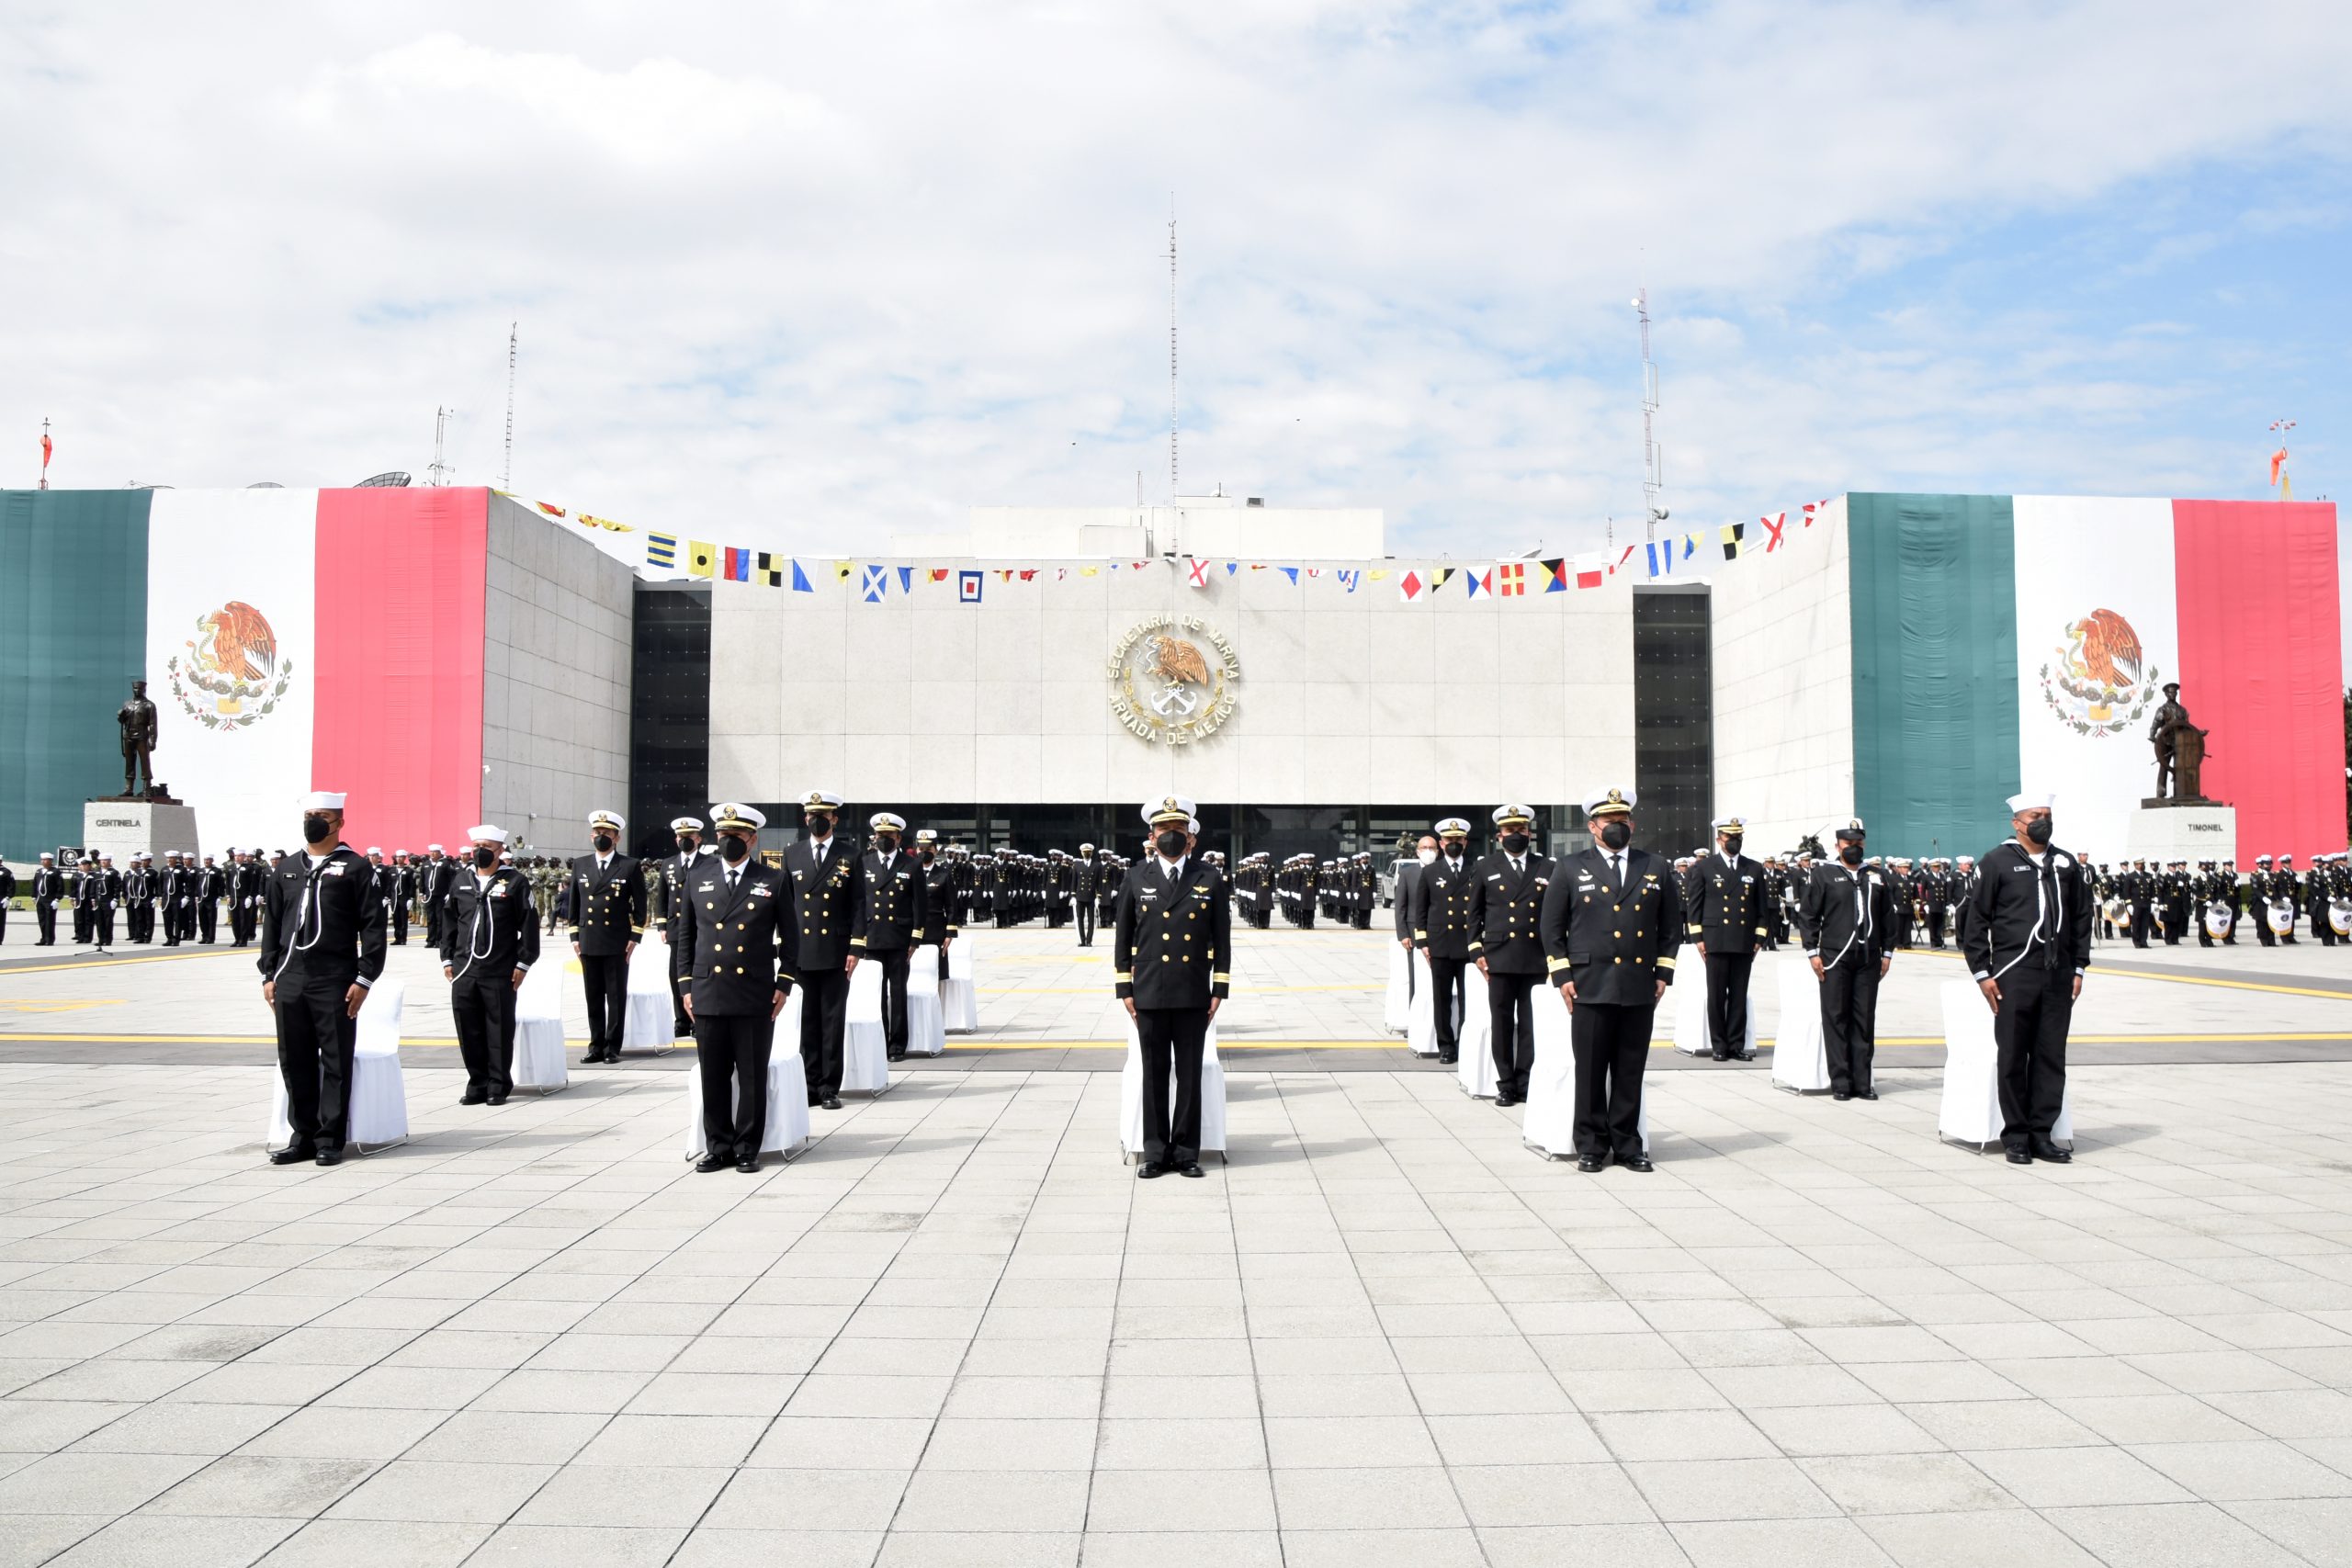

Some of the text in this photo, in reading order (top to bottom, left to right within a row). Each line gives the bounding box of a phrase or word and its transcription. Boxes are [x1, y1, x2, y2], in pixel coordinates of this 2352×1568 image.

[1107, 614, 1239, 680] SECRETARIA DE MARINA
[1109, 694, 1237, 745] ARMADA DE MEXICO
[96, 818, 141, 828] CENTINELA
[2188, 823, 2223, 832] TIMONEL
